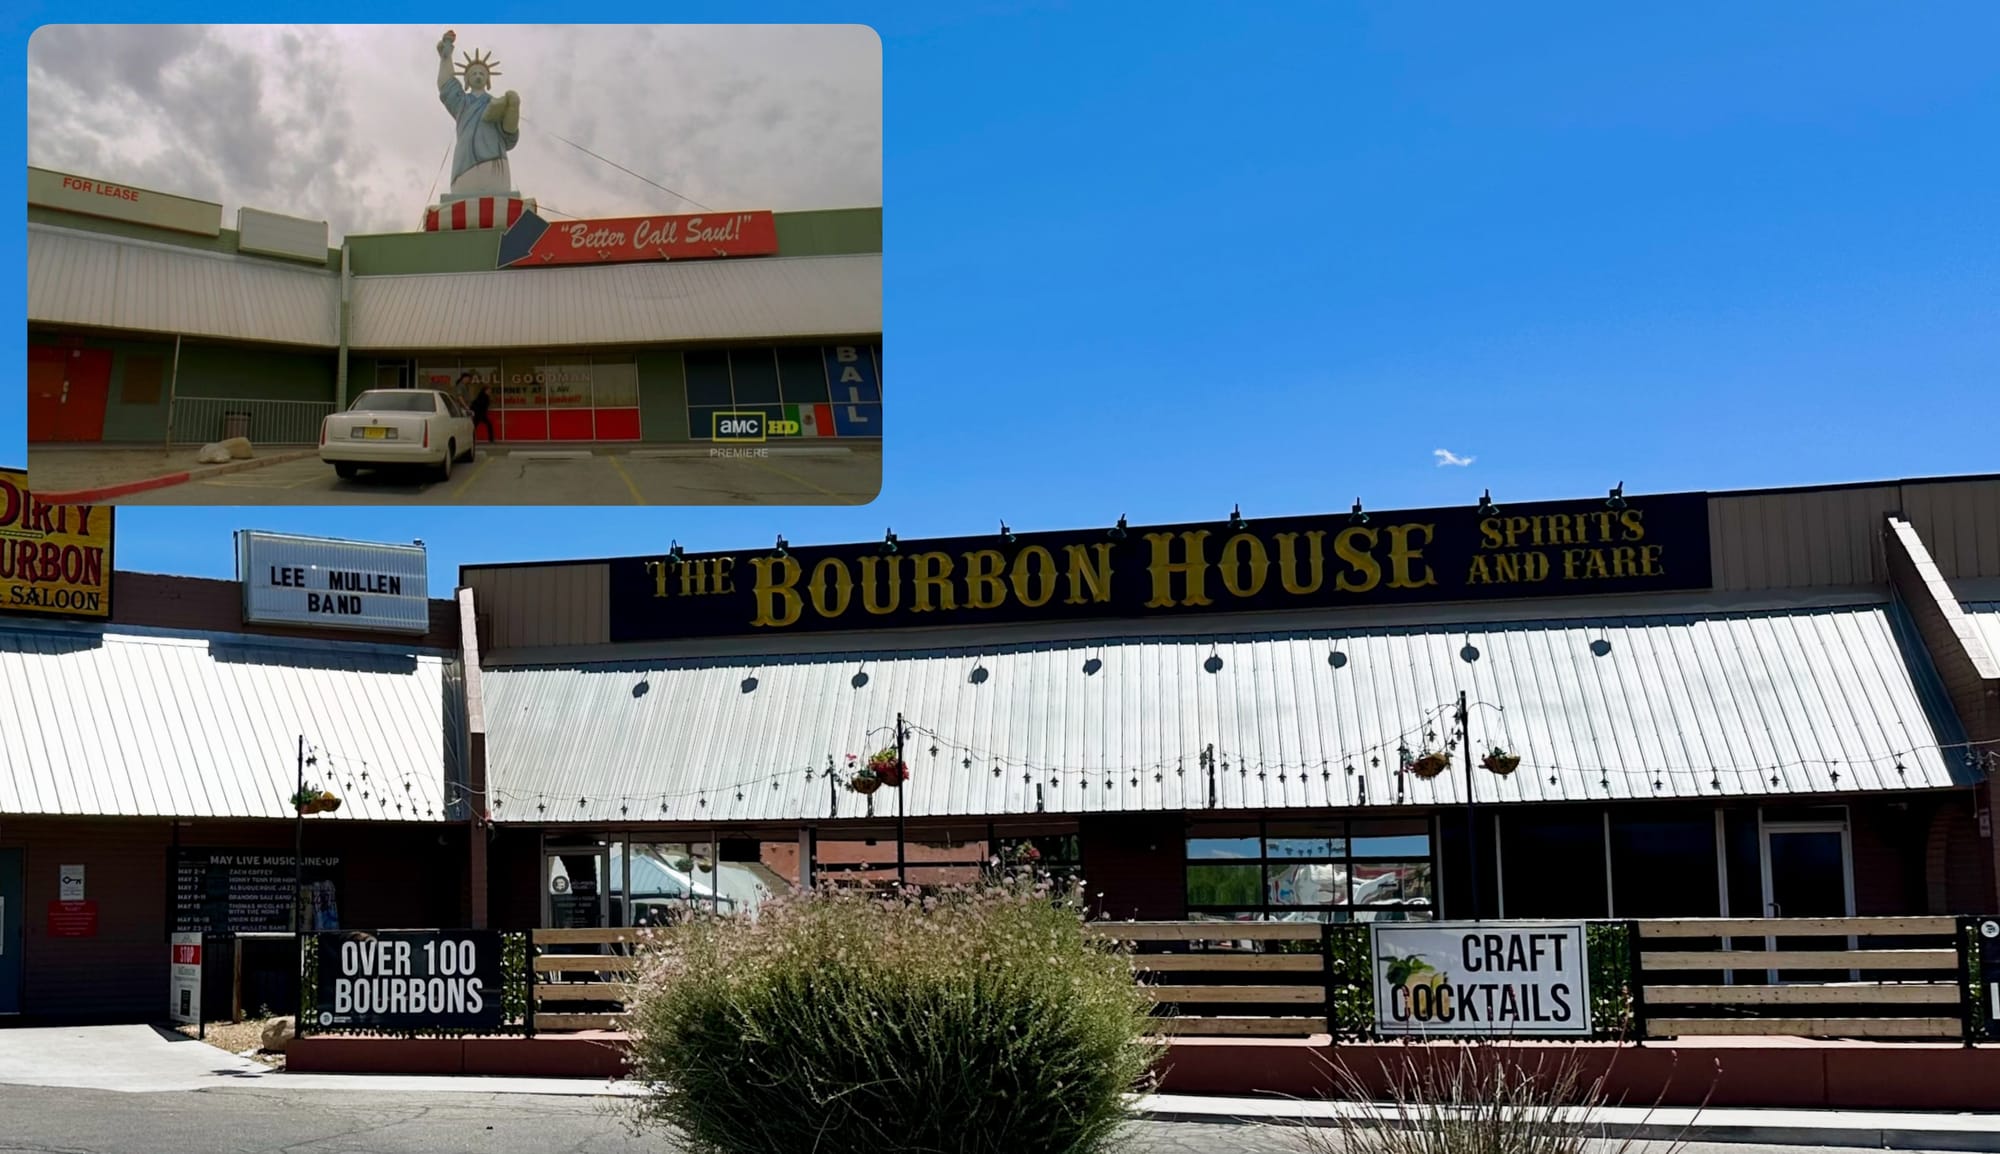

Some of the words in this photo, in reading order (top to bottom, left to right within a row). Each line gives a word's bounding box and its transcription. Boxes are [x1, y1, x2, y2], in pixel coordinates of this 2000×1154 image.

[63, 177, 92, 192] FOR
[96, 183, 139, 202] LEASE
[561, 223, 625, 249] "Better
[633, 220, 677, 249] Call
[685, 215, 752, 243] Saul!"
[836, 346, 868, 422] BAIL
[1480, 509, 1646, 549] SPIRITS
[0, 538, 103, 586] URBON
[644, 556, 736, 598] THE
[748, 543, 1115, 628] BOURBON
[1143, 523, 1438, 608] HOUSE
[1465, 550, 1551, 585] AND
[1562, 544, 1665, 580] FARE
[10, 585, 99, 611] SALOON
[271, 566, 305, 588] LEE
[329, 571, 401, 595] MULLEN
[308, 593, 362, 615] BAND
[210, 855, 233, 866] MAY
[237, 856, 260, 866] LIVE
[263, 857, 296, 867] MUSIC
[177, 902, 192, 910] MAY
[341, 940, 411, 976] OVER
[423, 940, 476, 976] 100
[1462, 934, 1568, 972] CRAFT
[335, 977, 484, 1014] BOURBONS
[1391, 983, 1571, 1022] COCKTAILS
